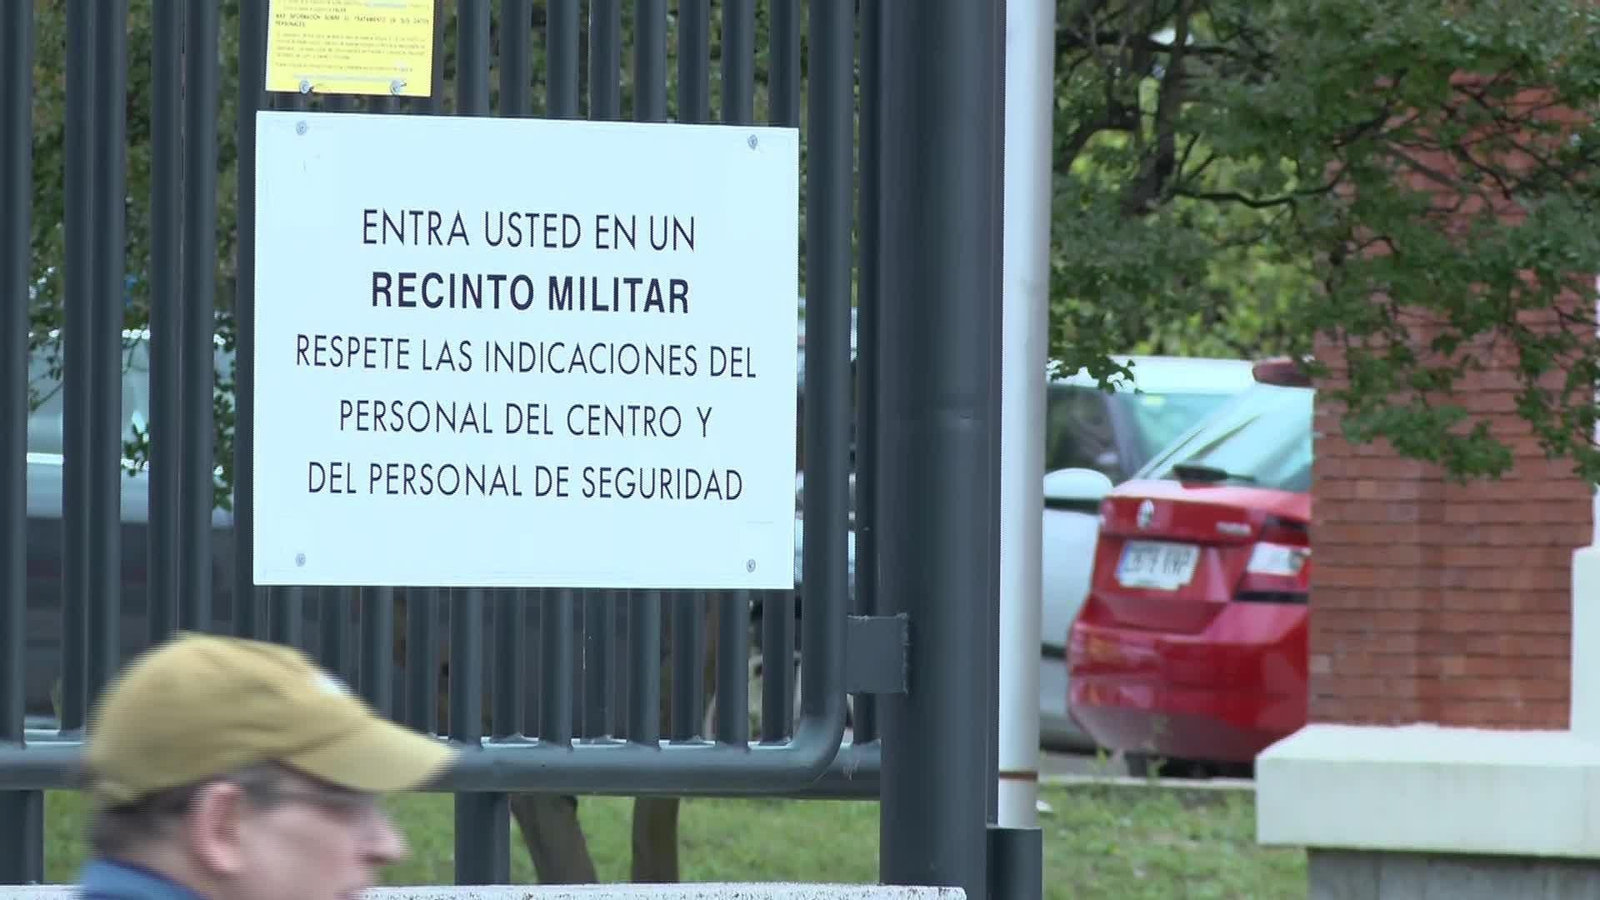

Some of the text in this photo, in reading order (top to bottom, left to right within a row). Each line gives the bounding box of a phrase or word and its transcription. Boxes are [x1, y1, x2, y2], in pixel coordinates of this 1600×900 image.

[363, 209, 694, 250] ENTRA USTED EN UN
[372, 272, 688, 313] RECINTO MILITAR
[297, 334, 756, 378] RESPETE LAS INDICACIONES DEL
[341, 400, 713, 437] PERSONAL DEL CENTRO Y
[309, 462, 742, 500] DEL PERSONAL DE SEGURIDAD
